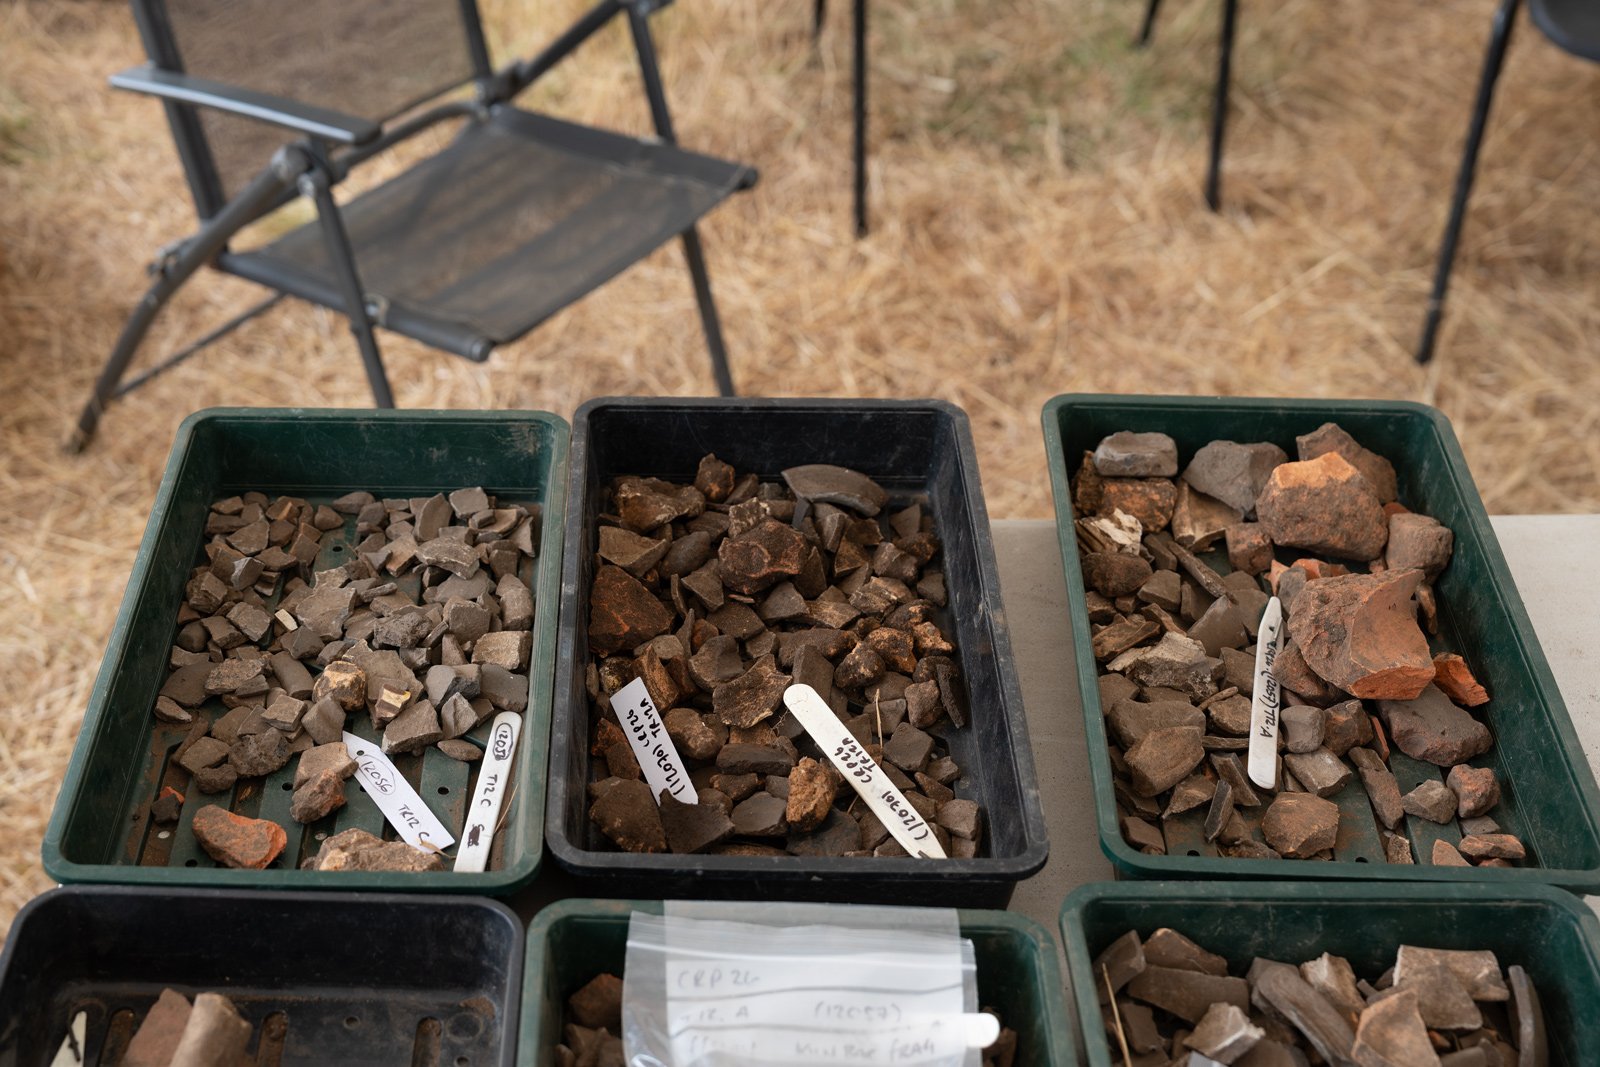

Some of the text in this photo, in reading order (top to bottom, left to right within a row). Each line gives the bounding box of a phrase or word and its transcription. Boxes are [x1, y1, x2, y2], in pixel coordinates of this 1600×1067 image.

[627, 709, 650, 747] CRP26
[640, 698, 660, 738] TR12A
[653, 744, 686, 796] (12070)
[834, 747, 872, 783] CRP26
[842, 737, 876, 772] TR12A
[360, 761, 393, 793] 12056
[399, 804, 420, 829] TR12
